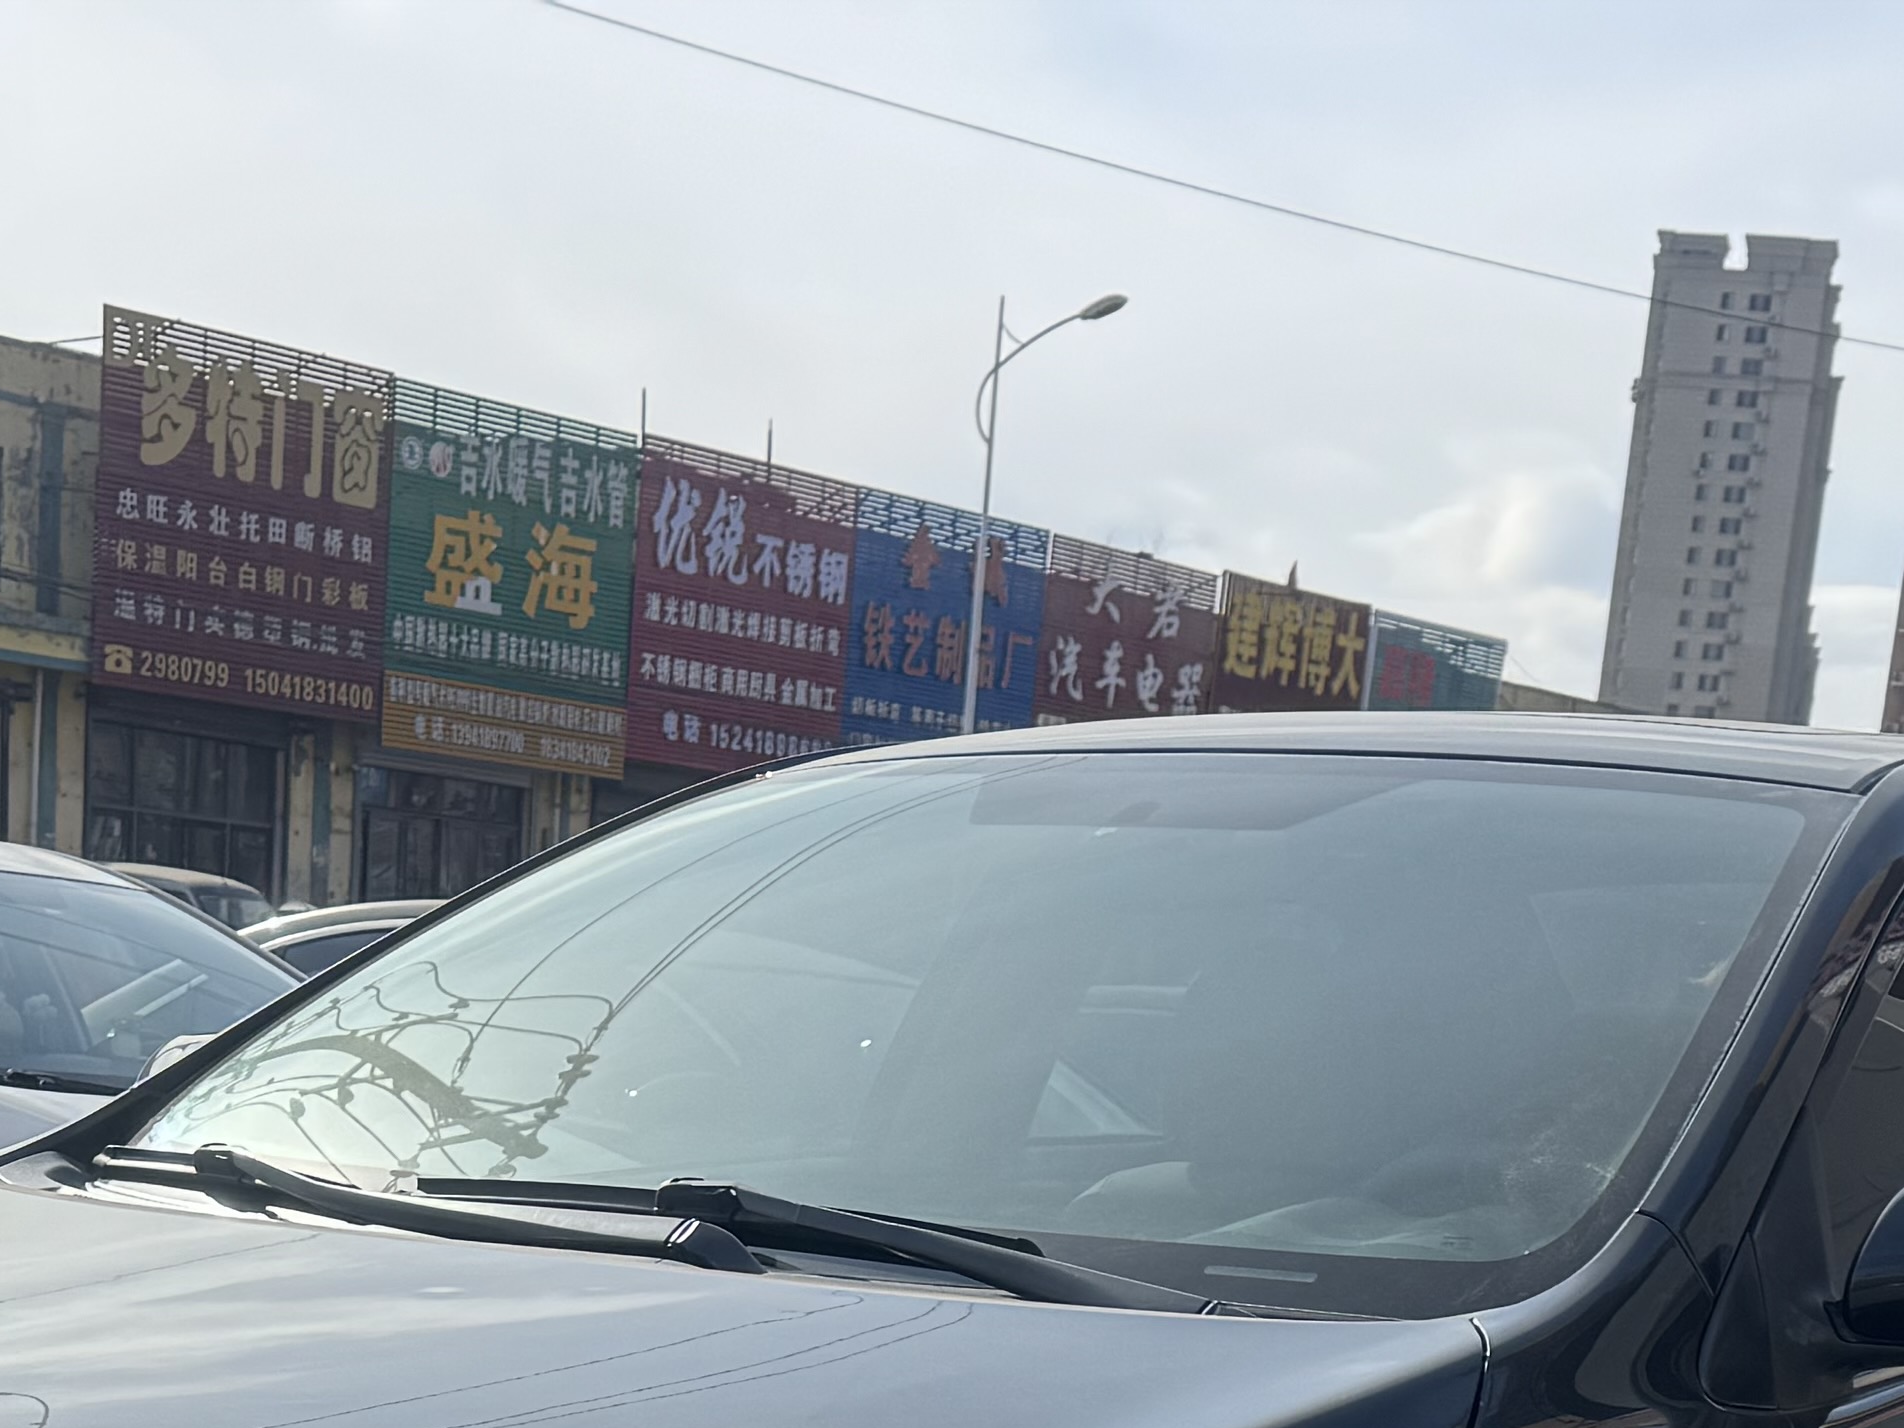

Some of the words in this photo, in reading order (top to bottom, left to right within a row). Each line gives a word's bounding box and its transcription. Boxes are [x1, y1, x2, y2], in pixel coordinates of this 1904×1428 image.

[423, 509, 599, 630] 盛海
[139, 650, 230, 689] 2980799
[863, 599, 1034, 690] 铁艺制品厂
